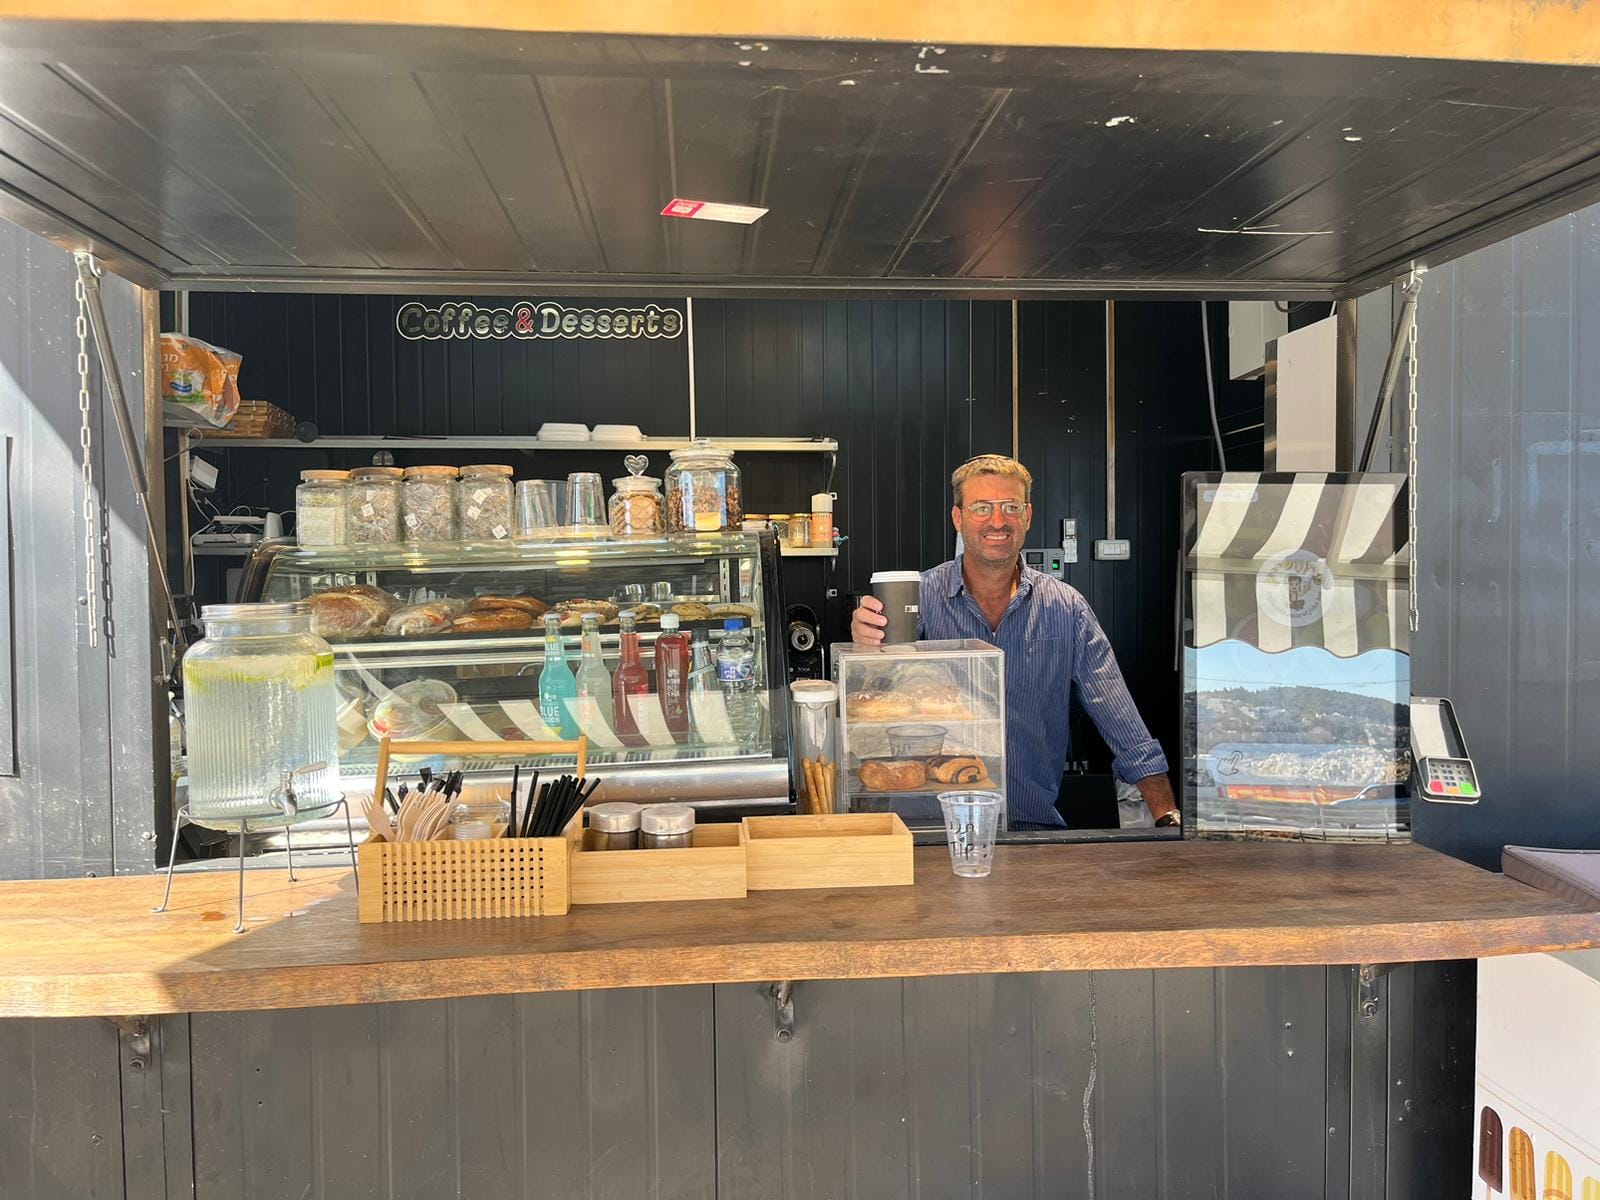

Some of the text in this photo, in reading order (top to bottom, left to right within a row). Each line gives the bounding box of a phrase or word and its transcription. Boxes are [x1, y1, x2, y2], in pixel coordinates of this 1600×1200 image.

[402, 307, 677, 334] Coffee & Desserts
